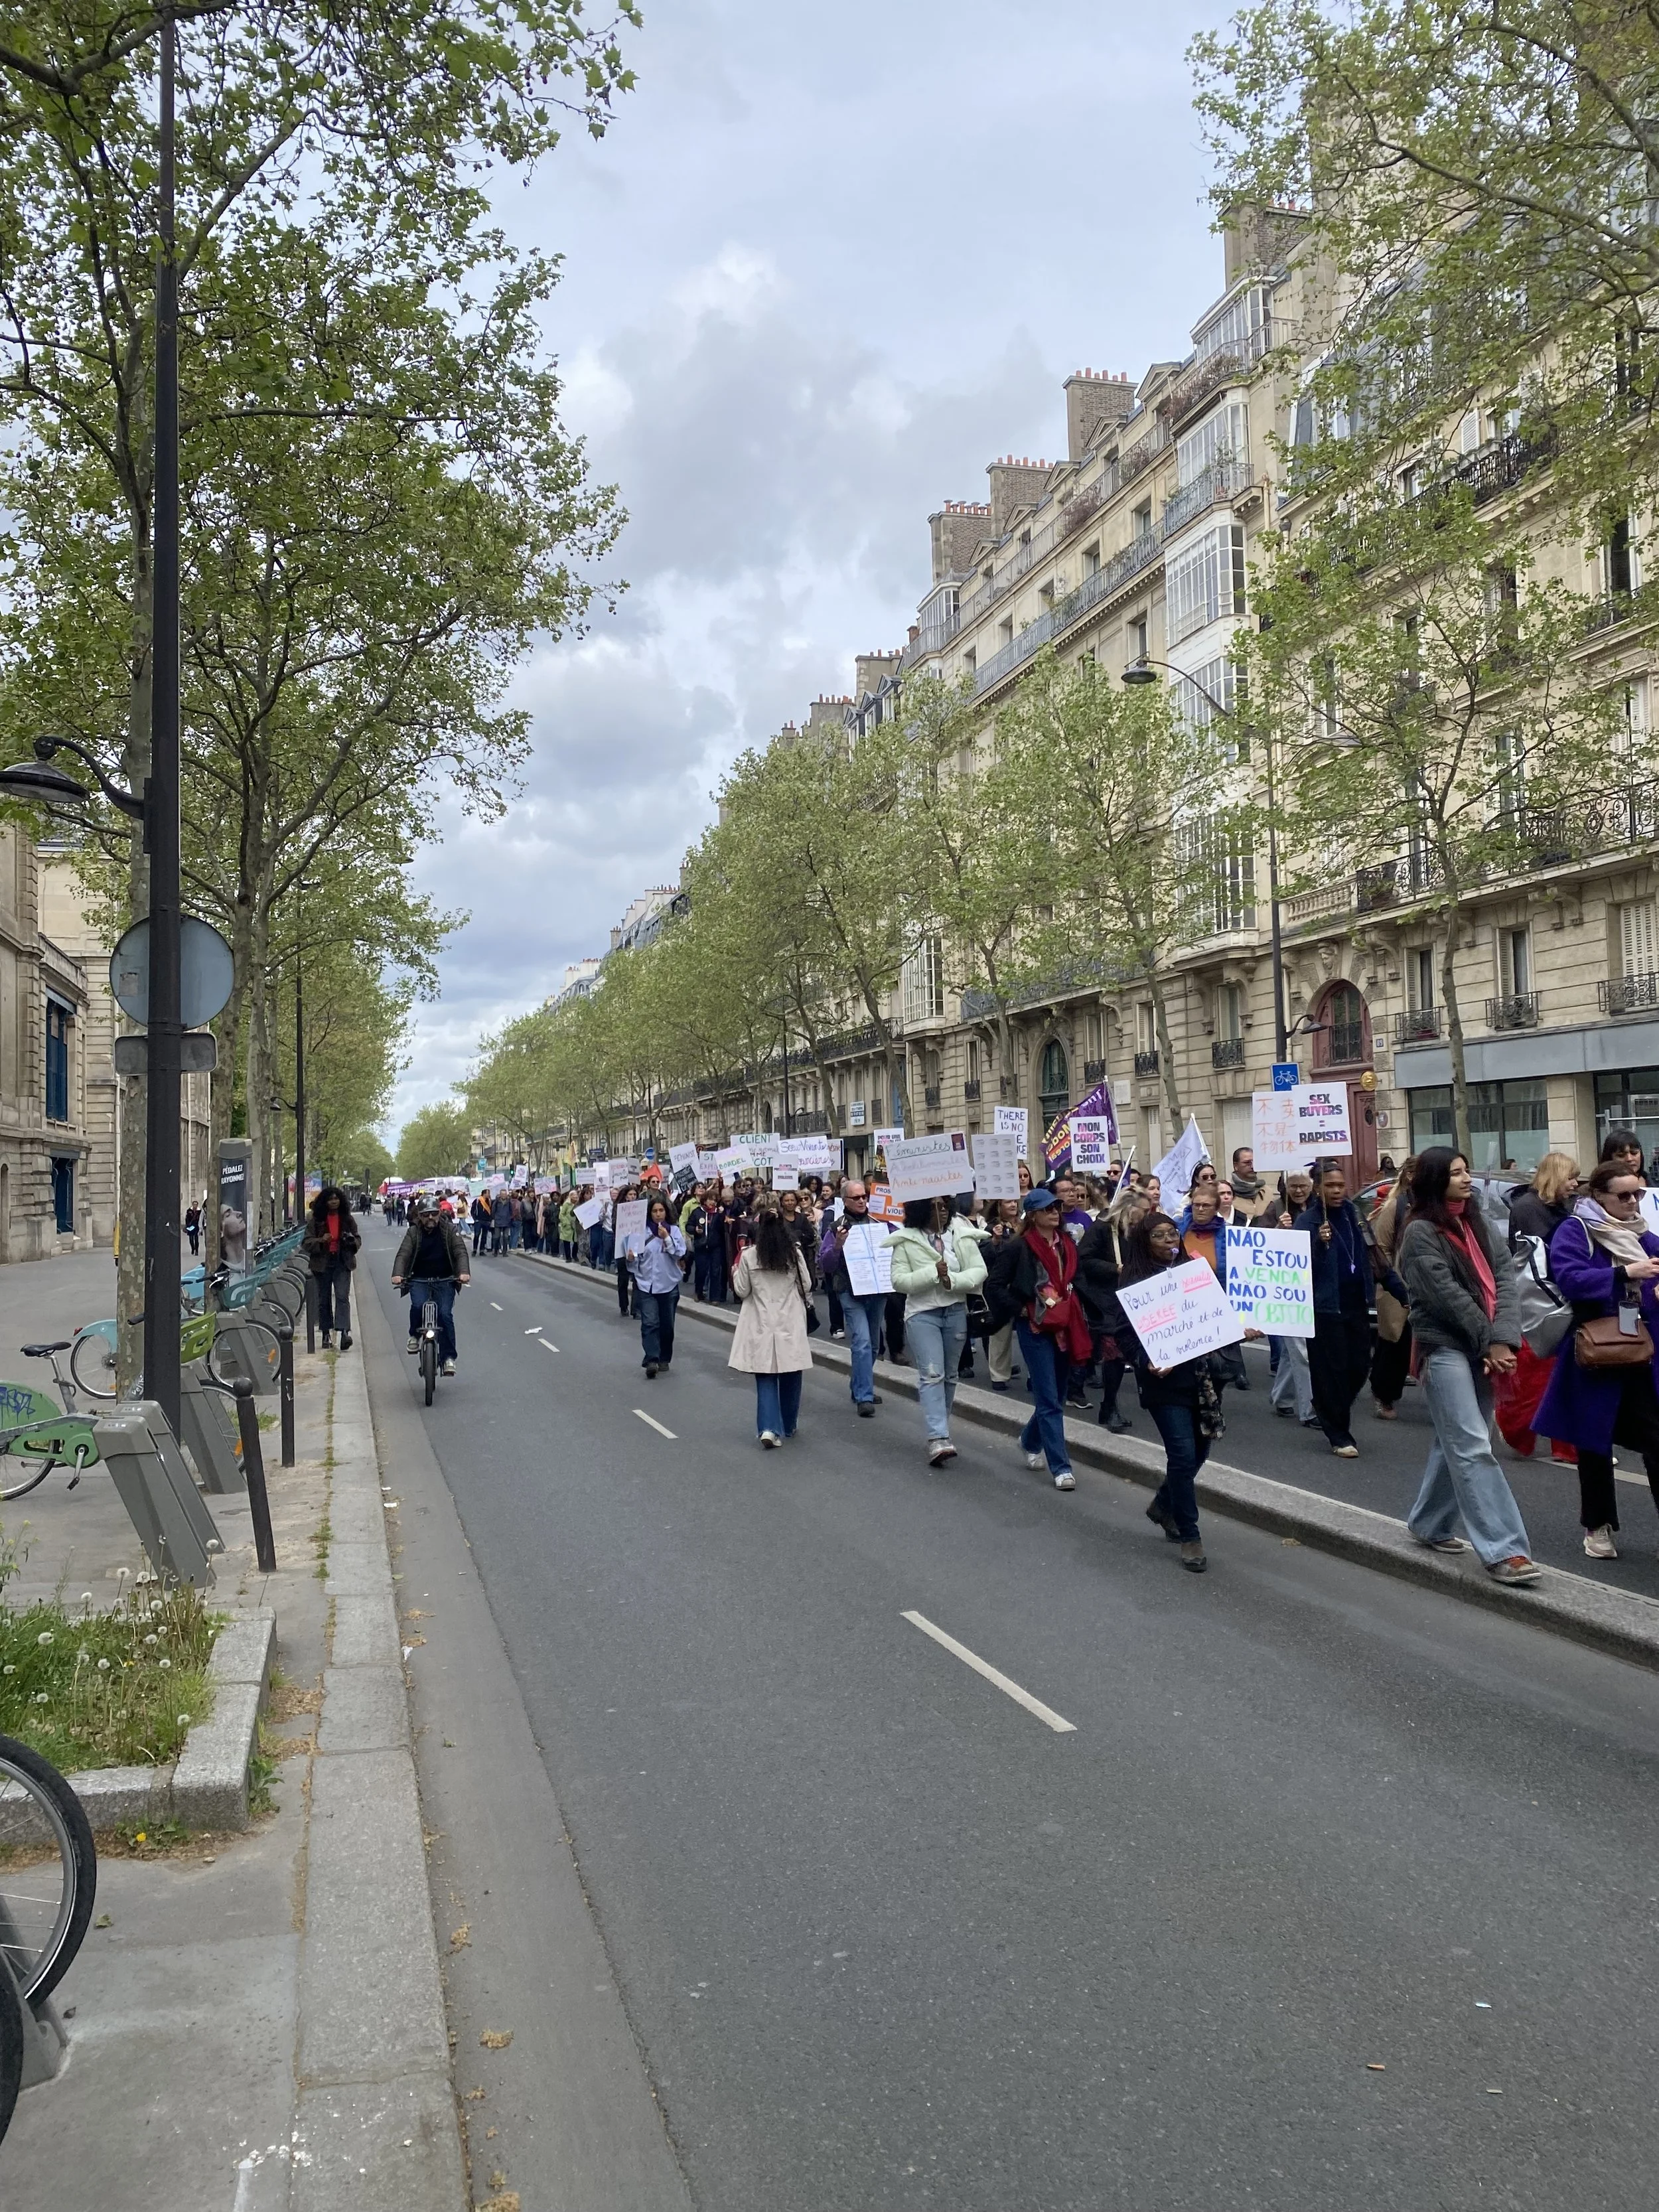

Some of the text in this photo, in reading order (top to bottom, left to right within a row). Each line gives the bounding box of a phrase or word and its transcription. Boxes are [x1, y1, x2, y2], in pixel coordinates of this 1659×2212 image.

[1309, 1094, 1331, 1104] SEX
[997, 1110, 1025, 1121] THERE
[1299, 1104, 1342, 1117] BUYERS
[1001, 1122, 1024, 1132] IS NO
[1077, 1122, 1100, 1132] MON
[739, 1134, 774, 1144] CLIENT
[1074, 1132, 1106, 1143] CORPS
[1080, 1143, 1100, 1153] SON
[719, 1157, 747, 1170] BORDEL
[1076, 1153, 1106, 1164] CHOIX
[222, 1164, 244, 1175] PÉDALEZ
[1228, 1228, 1266, 1247] NÃO
[1252, 1249, 1307, 1269] ESTOU
[1229, 1266, 1239, 1279] A
[1123, 1291, 1155, 1311] Pour
[1161, 1282, 1179, 1297] une
[1229, 1280, 1306, 1302] NÃO SOU
[1181, 1299, 1199, 1313] du
[1147, 1316, 1194, 1347] marché
[1212, 1307, 1223, 1318] de
[1155, 1348, 1171, 1362] la
